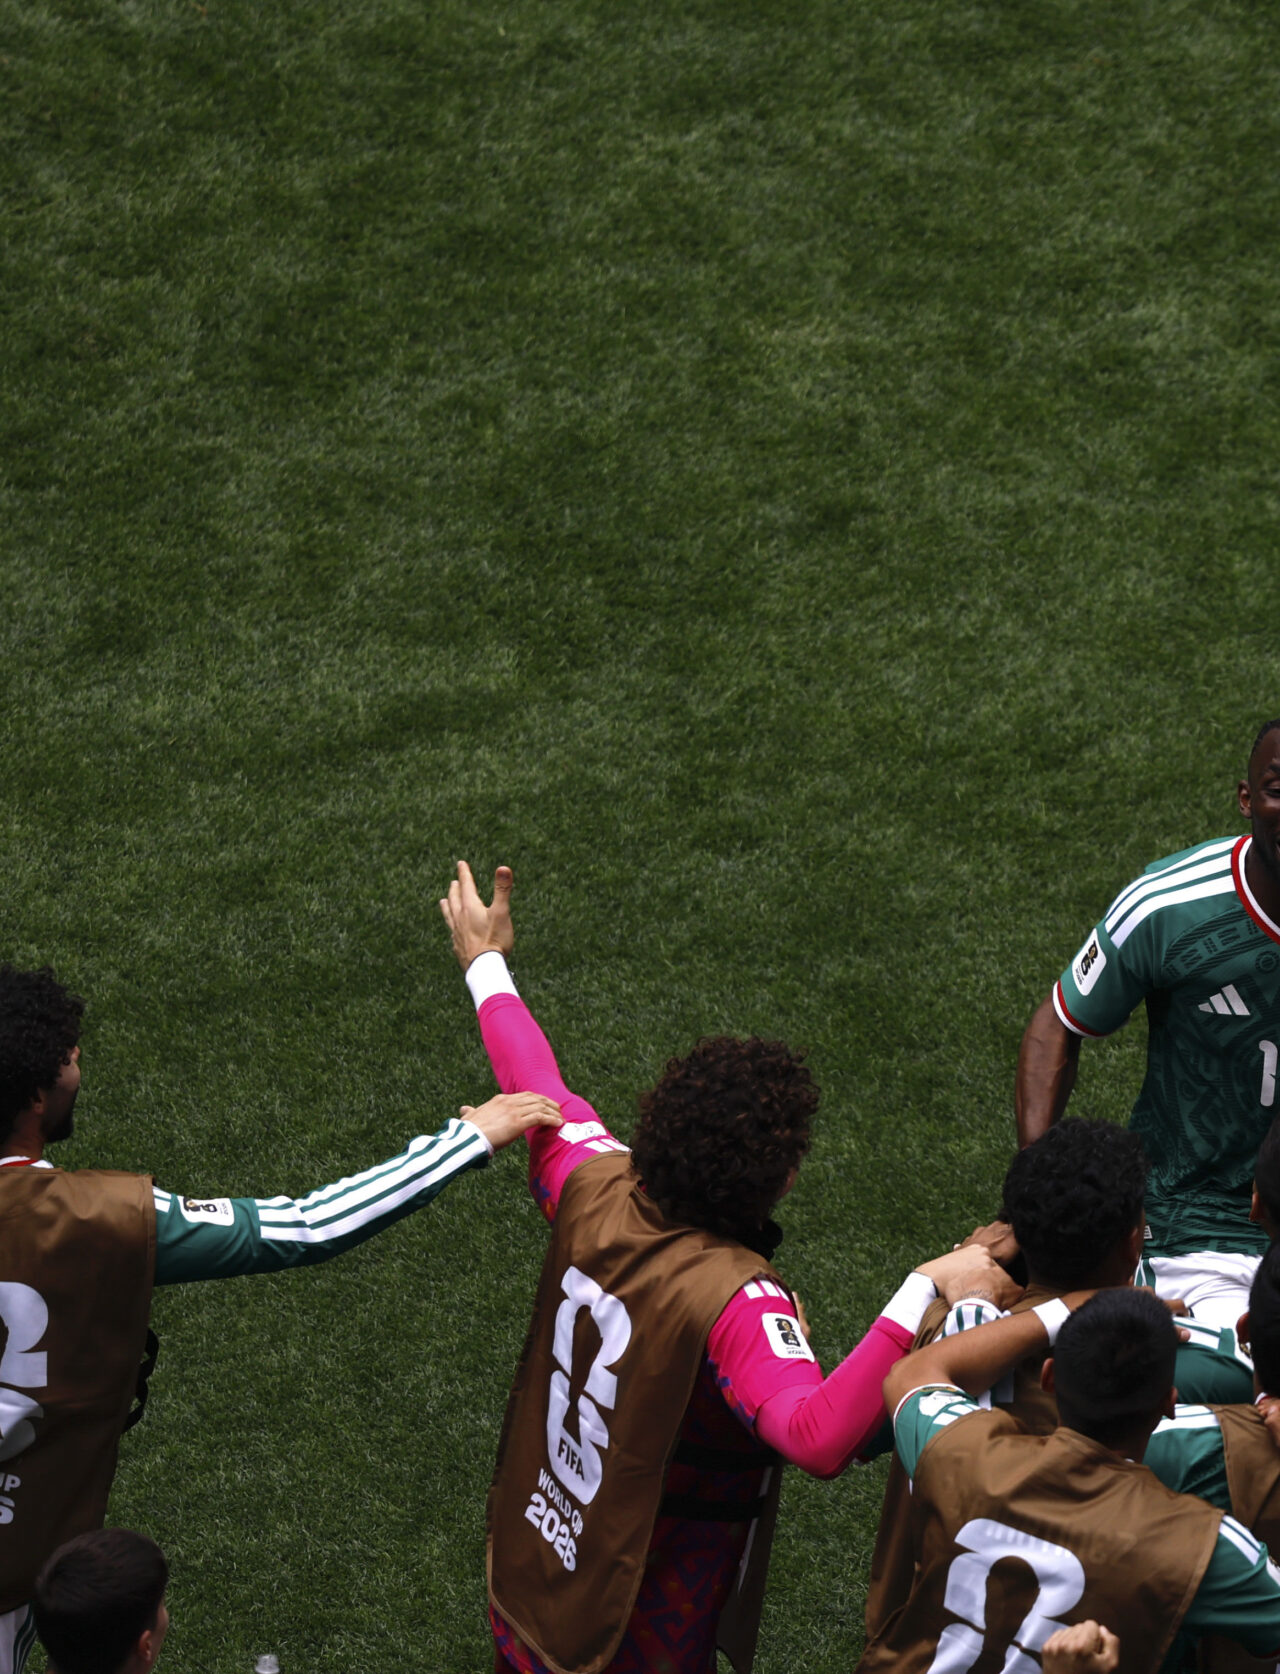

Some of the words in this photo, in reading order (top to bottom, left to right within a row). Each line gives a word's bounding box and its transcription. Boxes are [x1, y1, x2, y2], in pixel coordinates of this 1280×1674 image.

[558, 1437, 585, 1481] FIFA
[538, 1468, 571, 1518] WORLD
[524, 1492, 577, 1572] 2026
